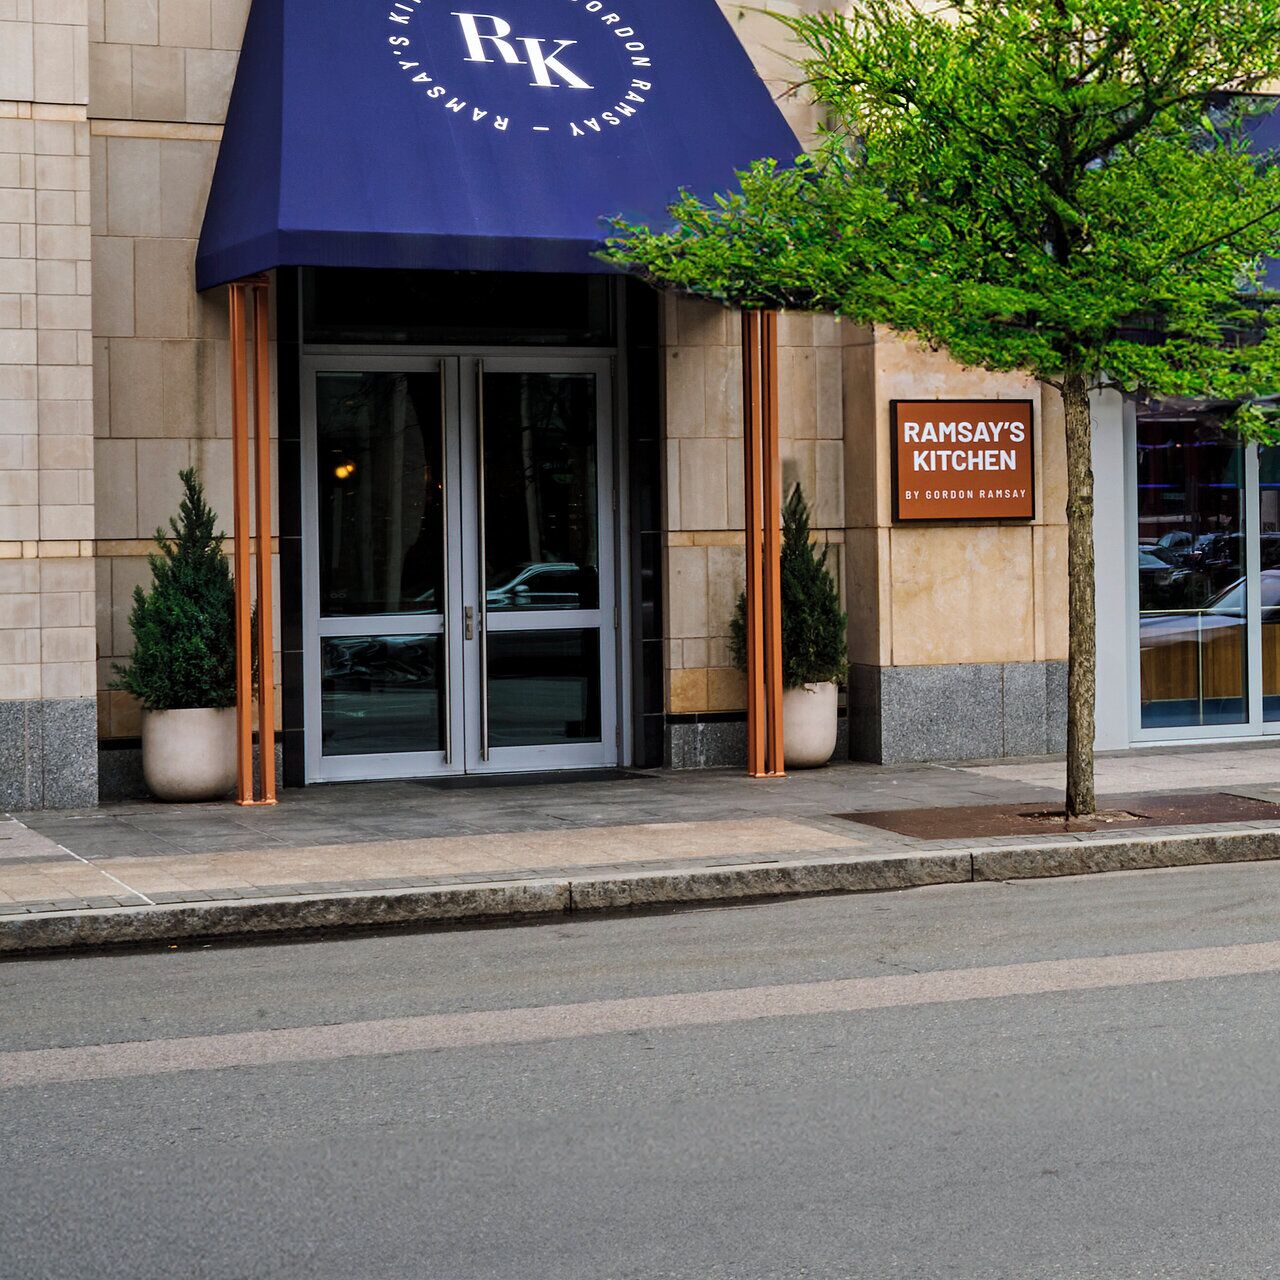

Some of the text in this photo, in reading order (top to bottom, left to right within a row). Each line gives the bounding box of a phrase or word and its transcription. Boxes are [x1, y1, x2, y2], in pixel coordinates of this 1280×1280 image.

[450, 11, 595, 90] RK
[388, 35, 509, 131] RAMSAY'S
[570, 78, 652, 137] RAMSAY
[904, 421, 1025, 443] RAMSAY'S
[913, 449, 1016, 471] KITCHEN
[905, 489, 1026, 500] BY GORDON RAMSAY
